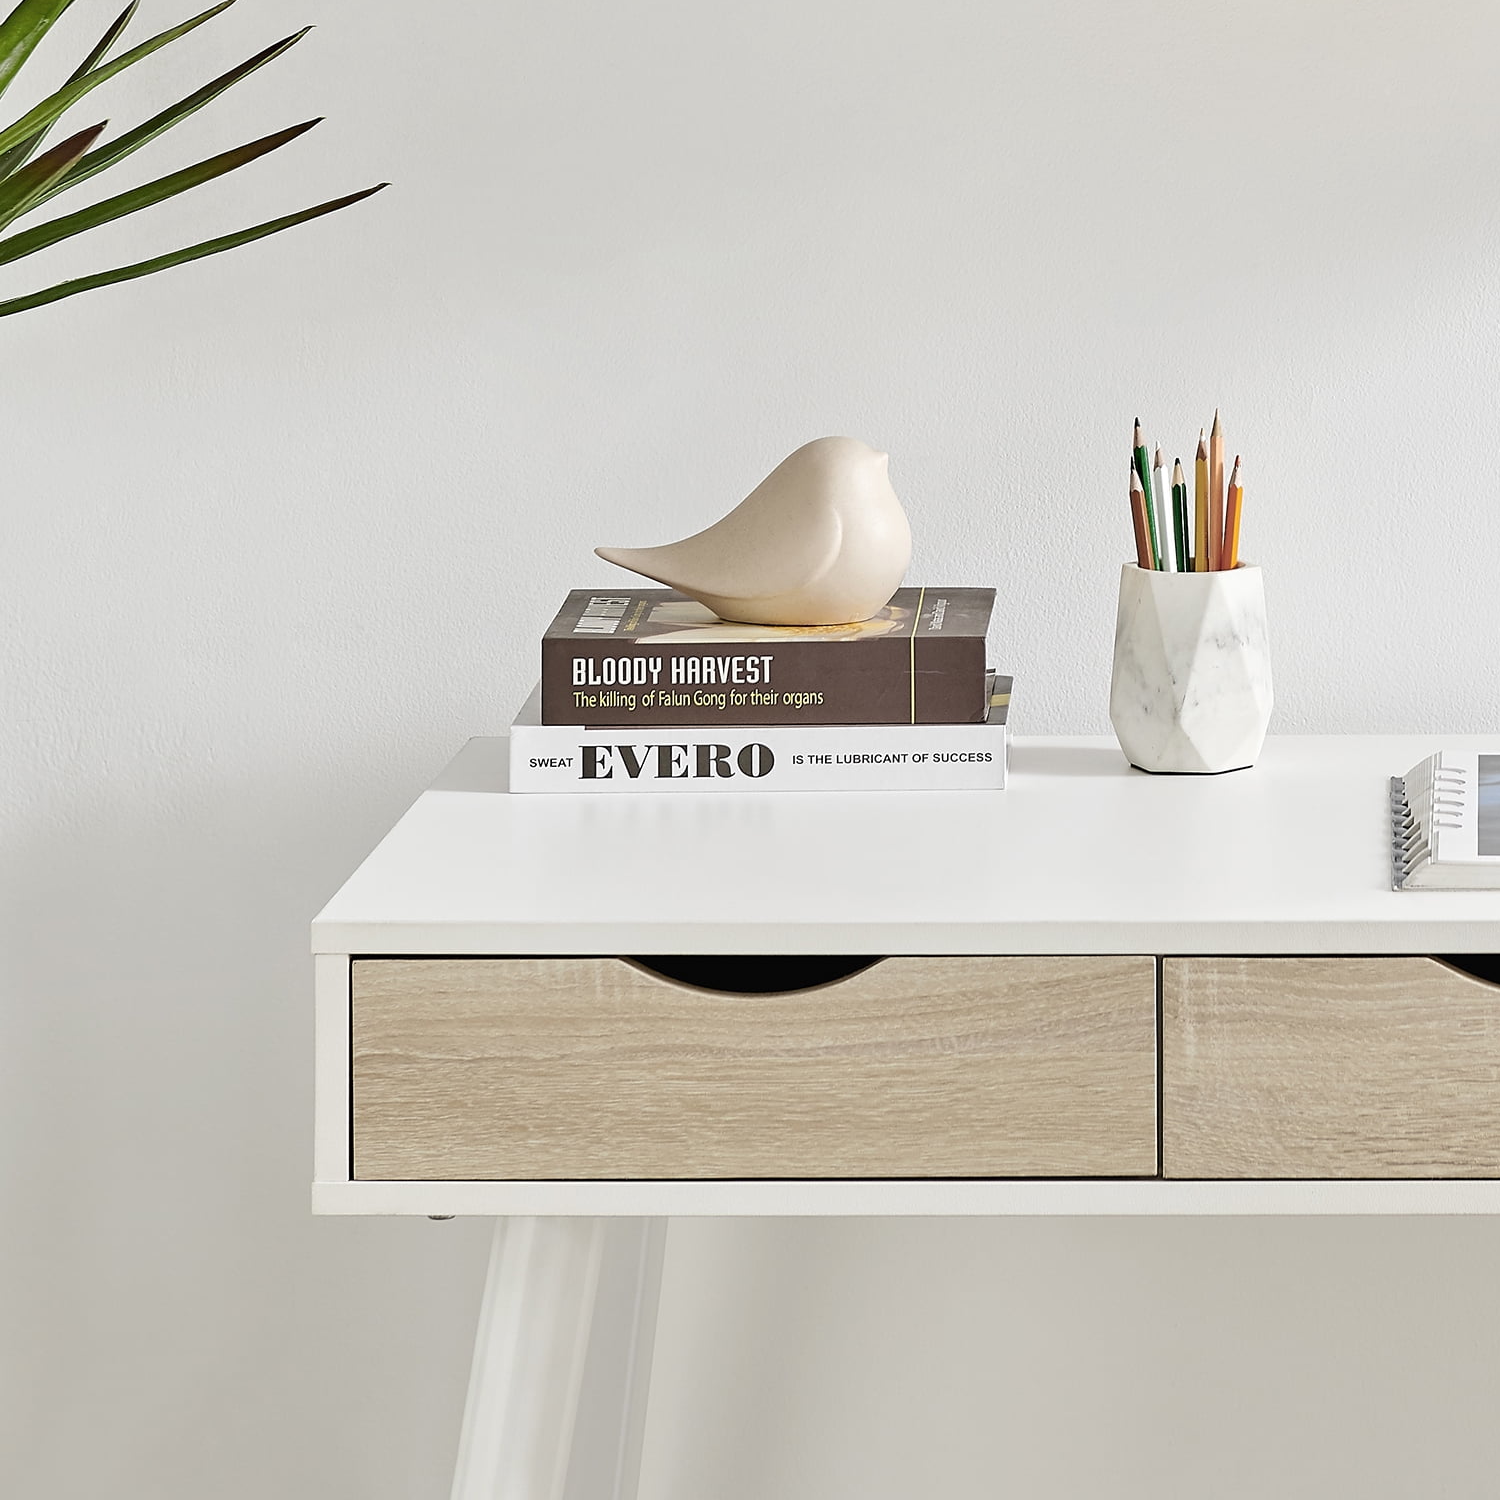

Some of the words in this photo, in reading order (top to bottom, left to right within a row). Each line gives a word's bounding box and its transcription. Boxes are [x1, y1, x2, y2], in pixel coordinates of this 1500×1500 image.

[573, 657, 661, 685] BLOODY
[671, 656, 773, 684] HARVEST
[573, 691, 596, 707] The
[600, 690, 636, 710] killing
[642, 690, 656, 707] of
[659, 690, 690, 706] Falun
[694, 690, 726, 709] Gong
[730, 689, 747, 705] for
[750, 689, 779, 705] their
[783, 692, 824, 708] organs
[529, 758, 574, 768] SWEAT
[578, 743, 775, 779] EVERO
[792, 755, 804, 764] IS
[808, 755, 832, 764] THE
[836, 754, 908, 764] LUBRICANT
[912, 753, 929, 763] OF
[933, 752, 993, 763] SUCCESS
